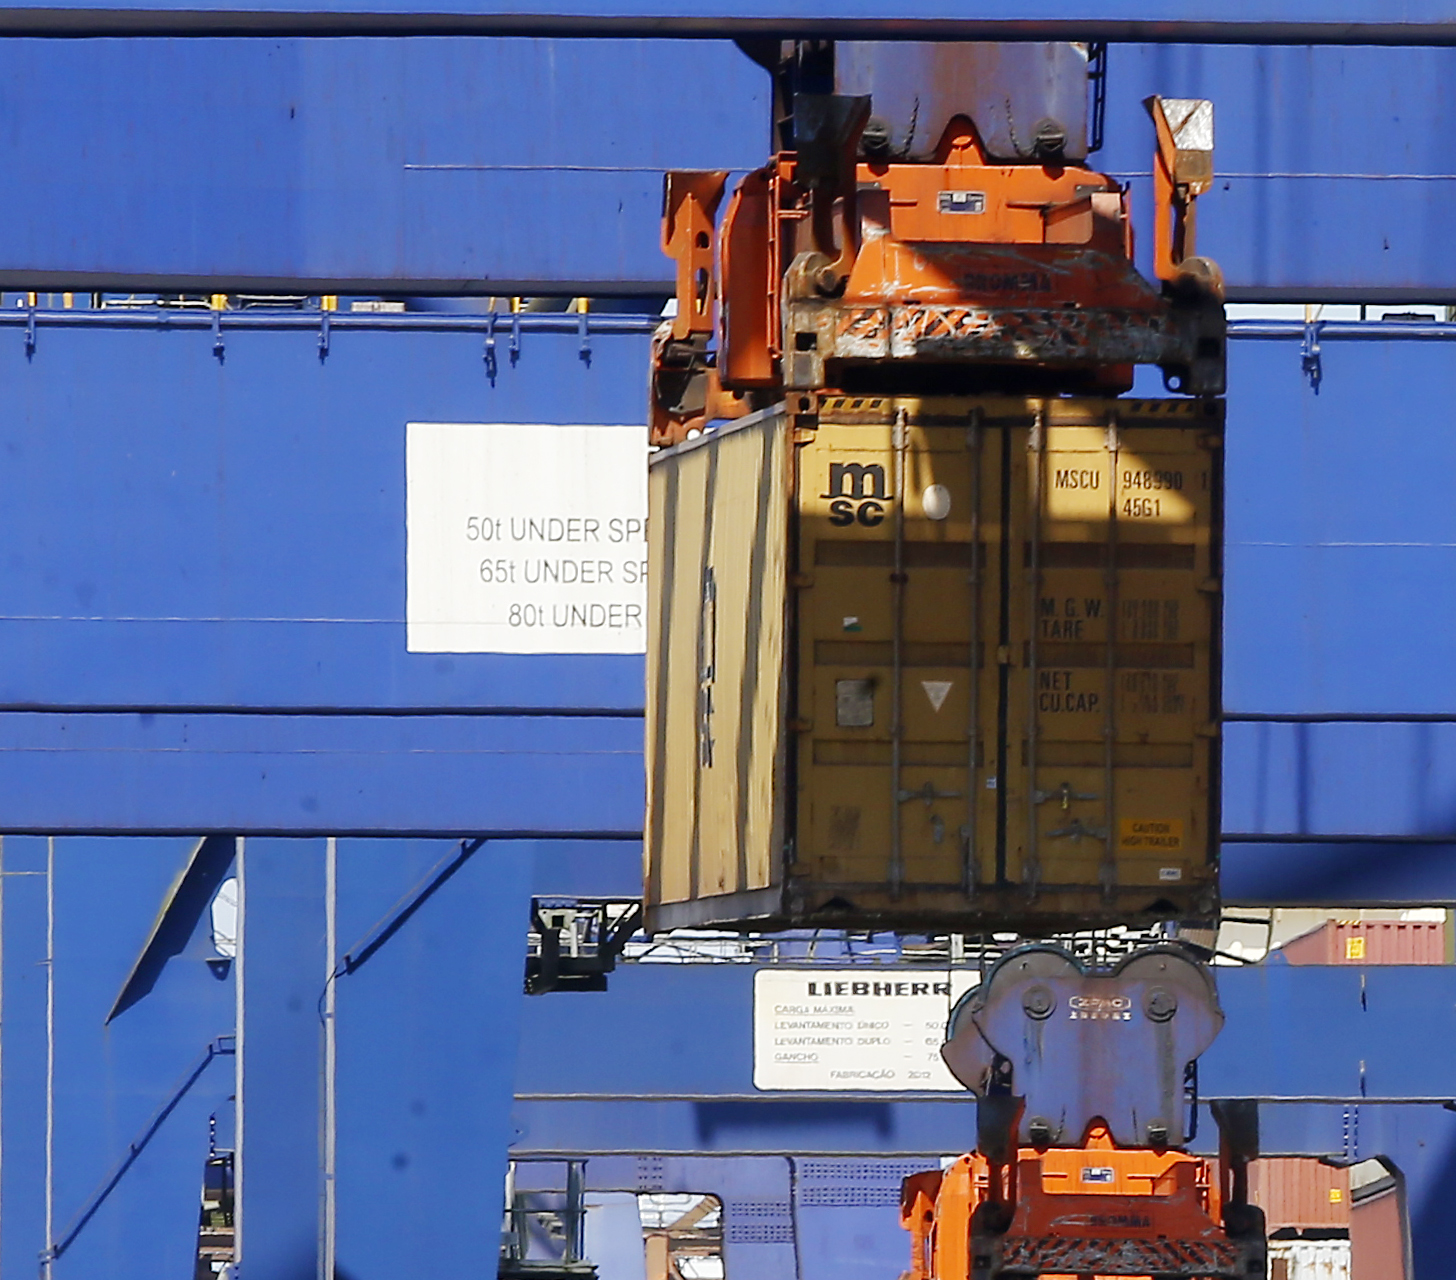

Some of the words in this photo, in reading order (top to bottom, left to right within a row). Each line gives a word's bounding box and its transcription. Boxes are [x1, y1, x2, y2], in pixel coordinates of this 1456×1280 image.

[1055, 470, 1100, 489] MSCU
[1123, 499, 1161, 517] 45G1
[466, 517, 502, 541] 50t
[510, 517, 600, 542] UNDER
[480, 559, 516, 583] 65t
[524, 559, 614, 583] UNDER
[508, 603, 544, 627] 80t
[552, 604, 642, 628] UNDER
[1042, 620, 1083, 639] TARE
[1040, 671, 1073, 690] NET
[808, 981, 952, 996] LIEBHERR
[774, 1005, 809, 1014] CARGA
[774, 1021, 853, 1030] LEVANTAMENTO
[774, 1037, 853, 1046] LEVANTAMENTO
[857, 1037, 891, 1046] DUPLO
[774, 1052, 819, 1061] GANCHO
[830, 1070, 895, 1080] FABRICAÇÃO
